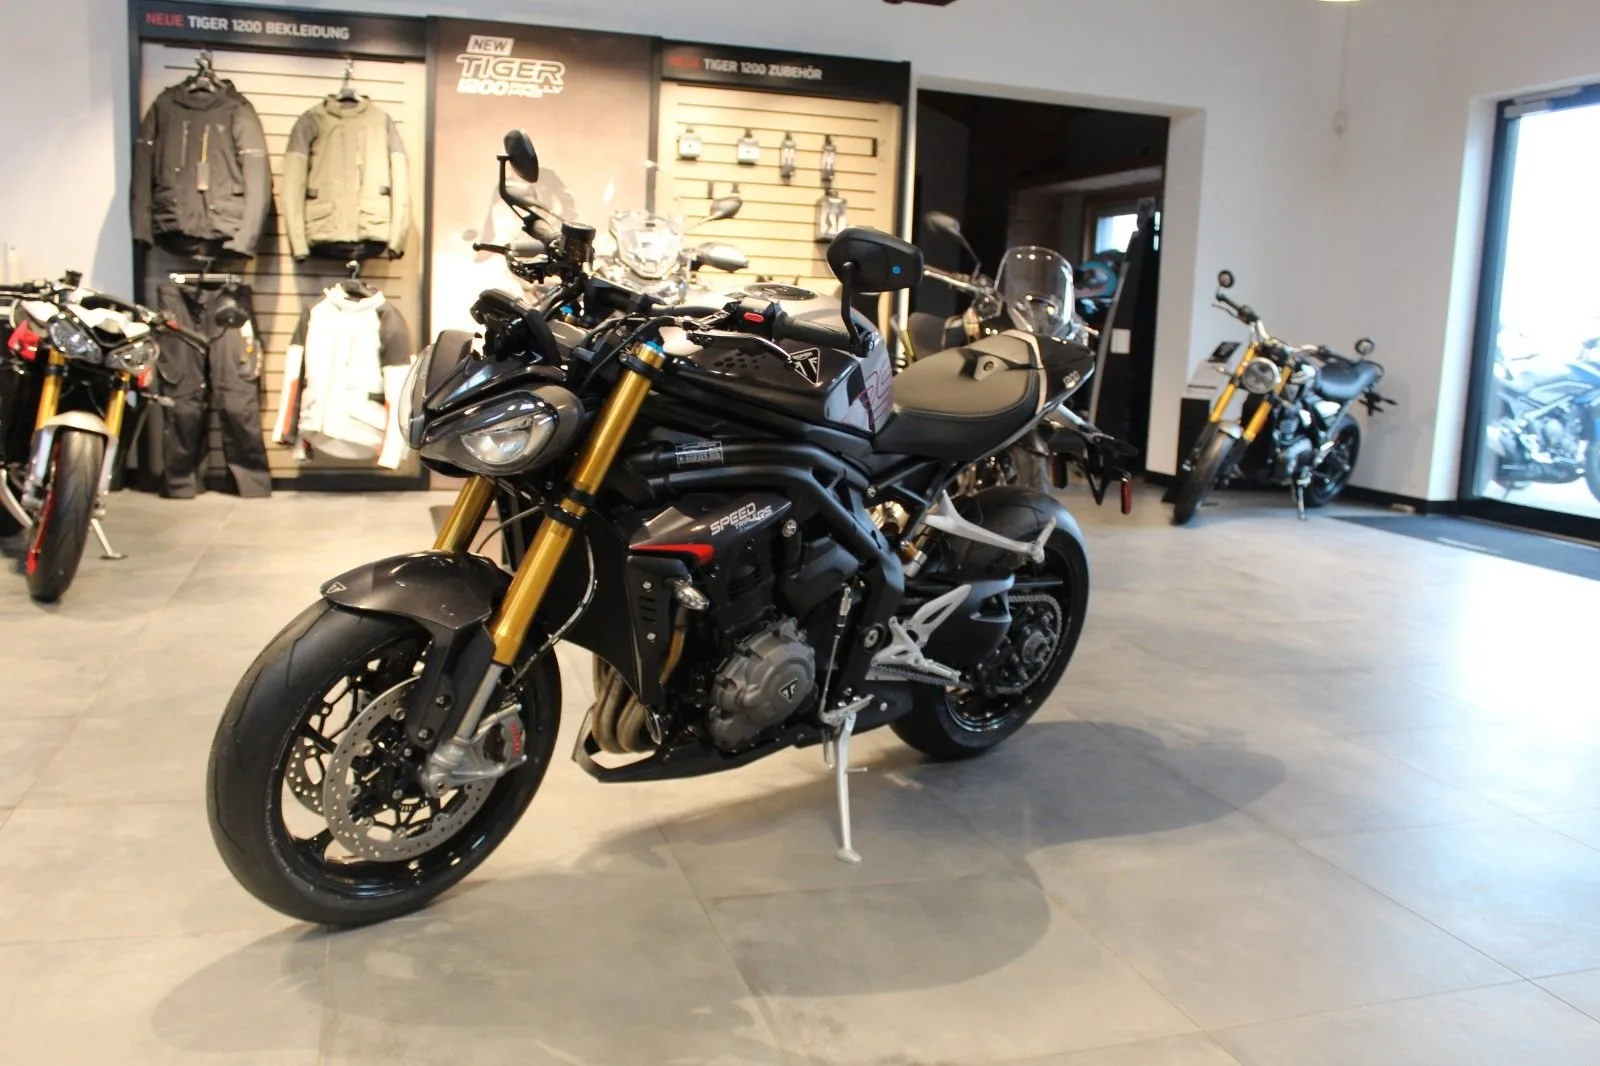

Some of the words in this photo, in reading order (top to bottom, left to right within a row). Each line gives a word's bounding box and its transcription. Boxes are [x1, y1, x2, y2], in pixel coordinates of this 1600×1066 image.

[146, 12, 184, 28] NEUE
[187, 15, 228, 31] TIGER
[231, 19, 262, 33] 1200
[265, 21, 350, 40] BEKLEIDUNG
[473, 39, 507, 52] NEW
[456, 54, 566, 85] TIGER
[703, 58, 738, 73] TIGER
[740, 61, 767, 75] 1200
[768, 64, 822, 80] ZUBEHÖR
[710, 502, 756, 536] SPEED
